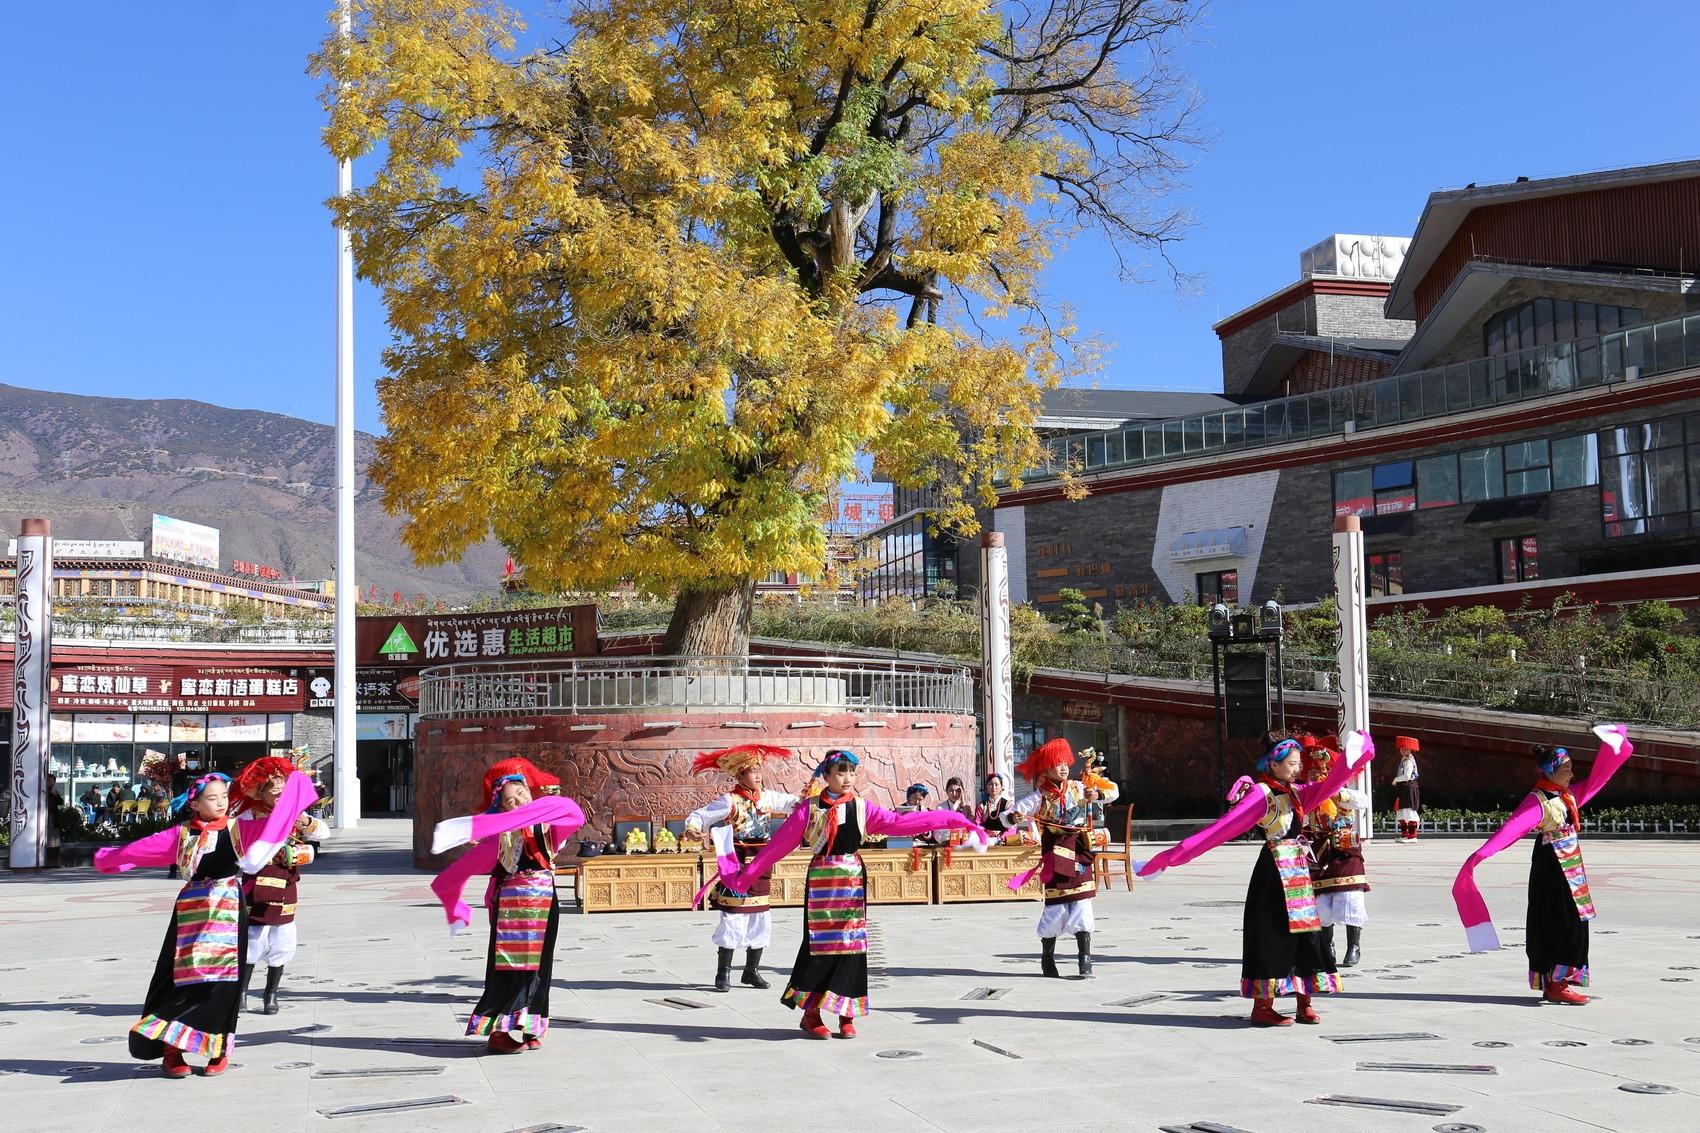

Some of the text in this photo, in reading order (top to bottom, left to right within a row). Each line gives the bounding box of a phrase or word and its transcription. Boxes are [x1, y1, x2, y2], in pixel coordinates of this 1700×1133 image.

[424, 625, 573, 659] 优选惠 生活超市
[61, 674, 148, 694] 蜜恋烧仙草
[181, 678, 298, 696] 蜜恋新语蛋糕店
[117, 698, 128, 706] 小吃
